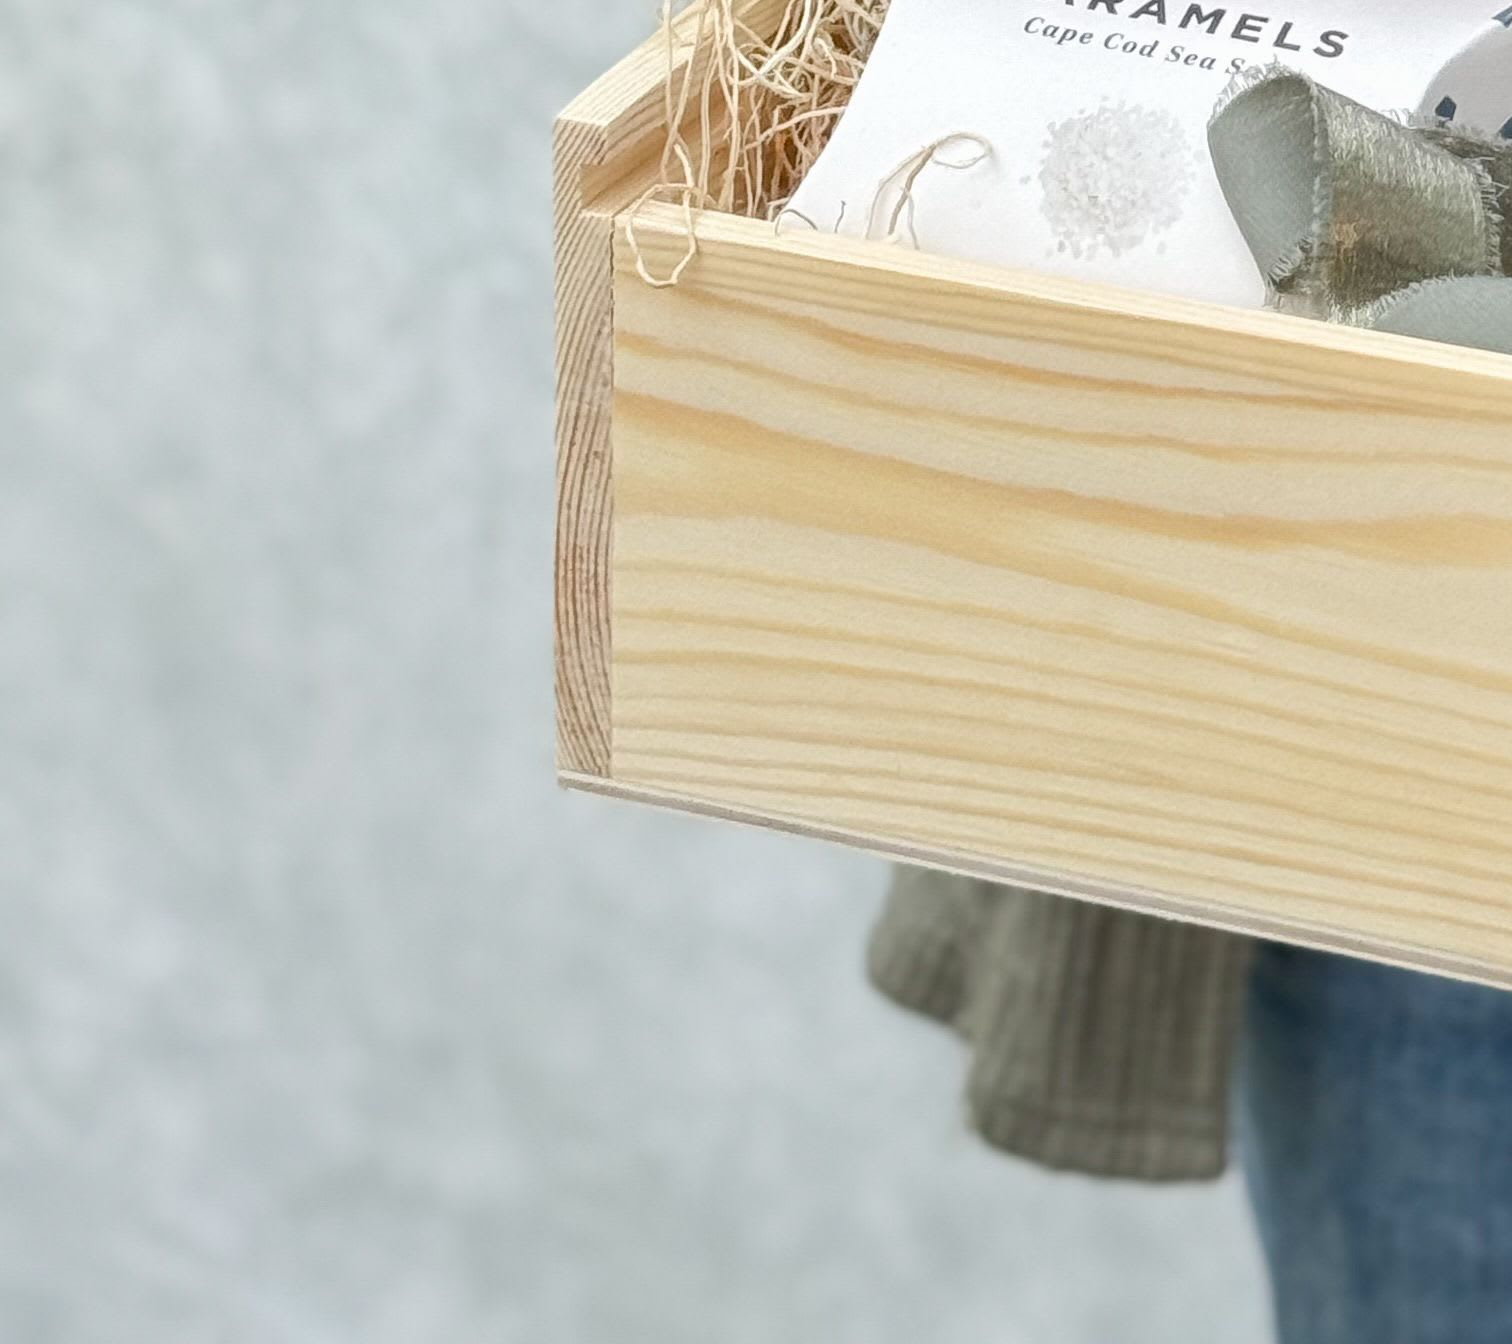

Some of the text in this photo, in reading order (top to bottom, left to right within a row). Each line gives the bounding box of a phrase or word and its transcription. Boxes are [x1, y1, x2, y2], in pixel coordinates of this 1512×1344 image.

[1023, 16, 1094, 46] Cape
[1103, 32, 1160, 58] Cod
[1164, 45, 1217, 70] Sea
